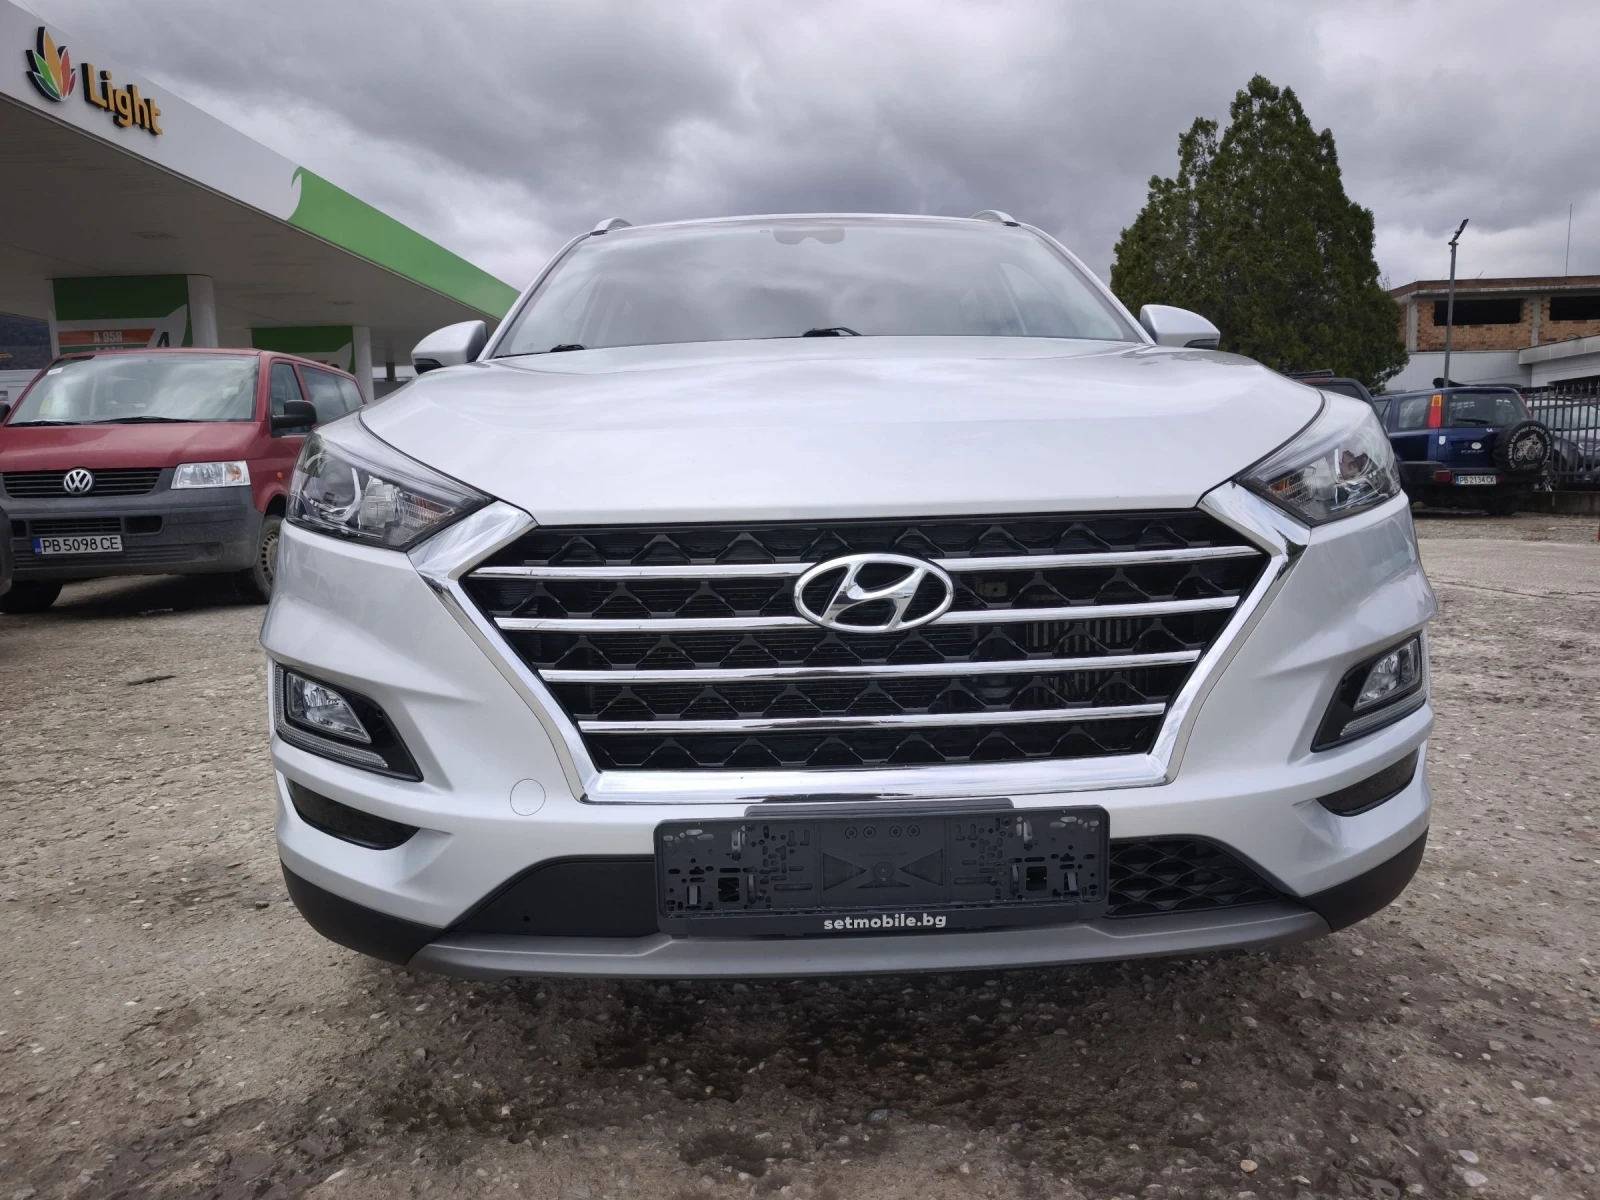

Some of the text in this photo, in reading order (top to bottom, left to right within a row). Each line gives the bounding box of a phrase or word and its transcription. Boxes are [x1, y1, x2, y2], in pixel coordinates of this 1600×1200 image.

[81, 63, 163, 135] Light
[42, 537, 120, 553] PB 5098 CE
[823, 912, 947, 930] setmobile.bg
